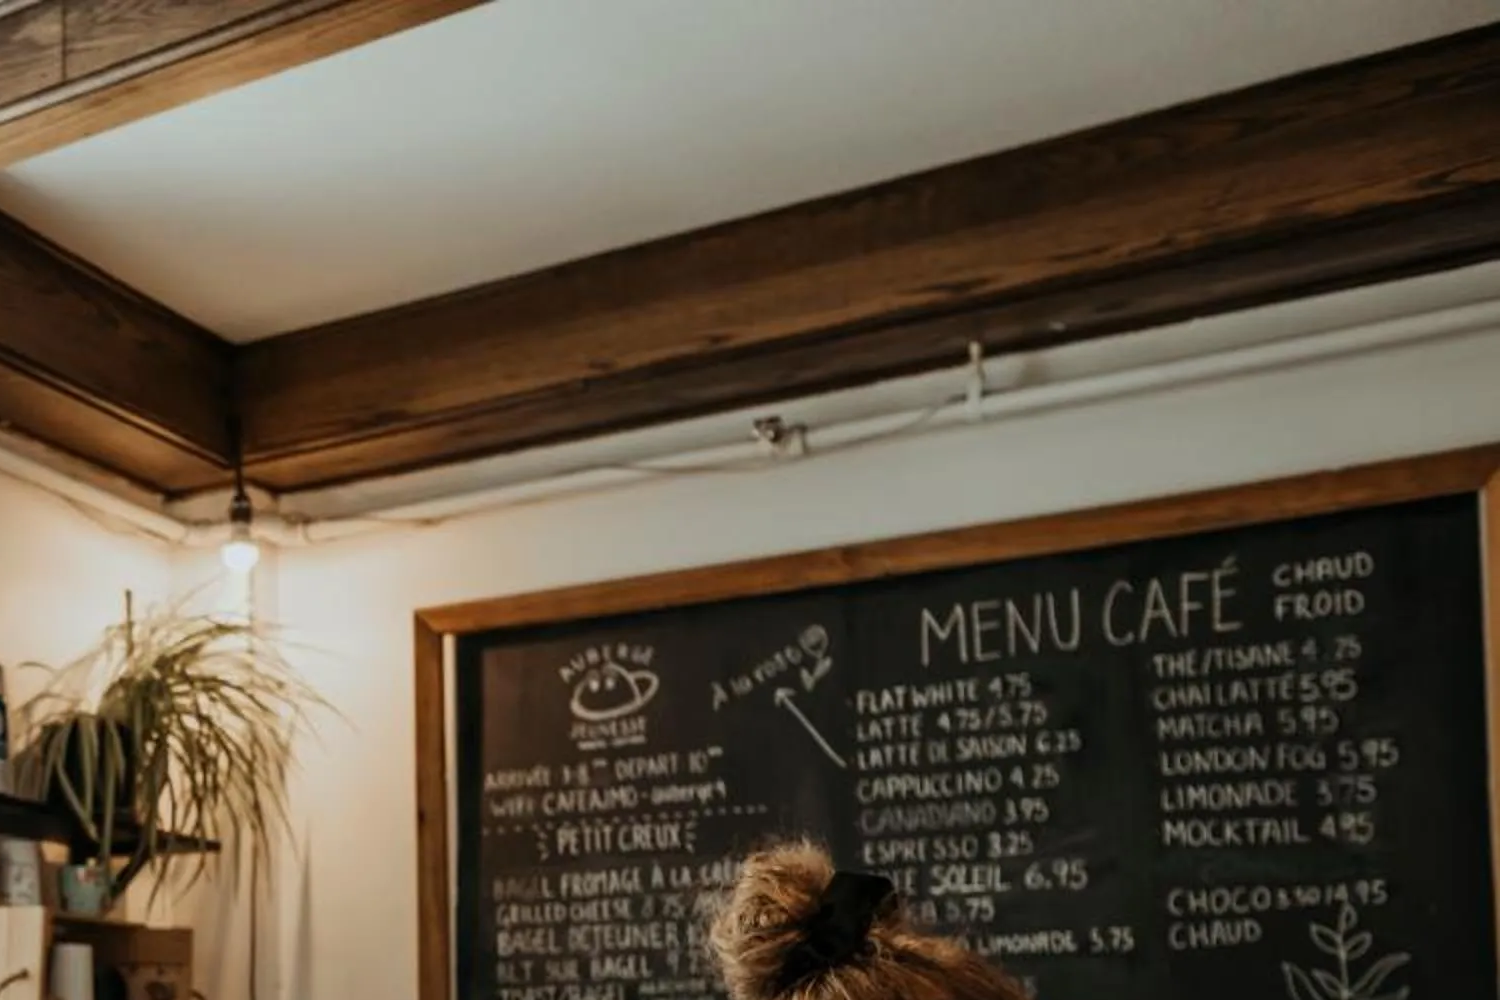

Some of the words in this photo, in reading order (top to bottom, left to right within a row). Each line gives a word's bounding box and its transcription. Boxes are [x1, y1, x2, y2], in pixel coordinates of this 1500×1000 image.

[1271, 551, 1374, 587] CHAUD
[920, 587, 1081, 668] MENU
[1101, 552, 1243, 647] CAFÉ
[1274, 590, 1365, 621] FROID
[857, 685, 908, 715] FLAT
[910, 678, 979, 708] WHITE
[1153, 683, 1211, 712] CHAI
[1216, 672, 1294, 707] LATTE
[857, 712, 923, 742] LATTE
[1157, 711, 1264, 740] MATCHA
[857, 740, 920, 770] LATTE
[1160, 744, 1272, 776] LONDON
[1275, 743, 1326, 770] FOG
[857, 766, 1002, 804] CAPPUCCINO
[1160, 780, 1299, 812] LIMONADE
[557, 822, 612, 856] PETIT
[617, 822, 681, 853] CREUX
[1163, 817, 1311, 847] MOCKTAIL
[863, 835, 979, 866] ESPRESSO
[560, 866, 643, 899] FROMAGE
[928, 864, 1012, 896] SOLEIL
[1024, 859, 1088, 891] 6.95
[1167, 884, 1272, 917] CHOCO
[978, 929, 1077, 957] LIMONADE
[1168, 918, 1263, 950] CHAUD
